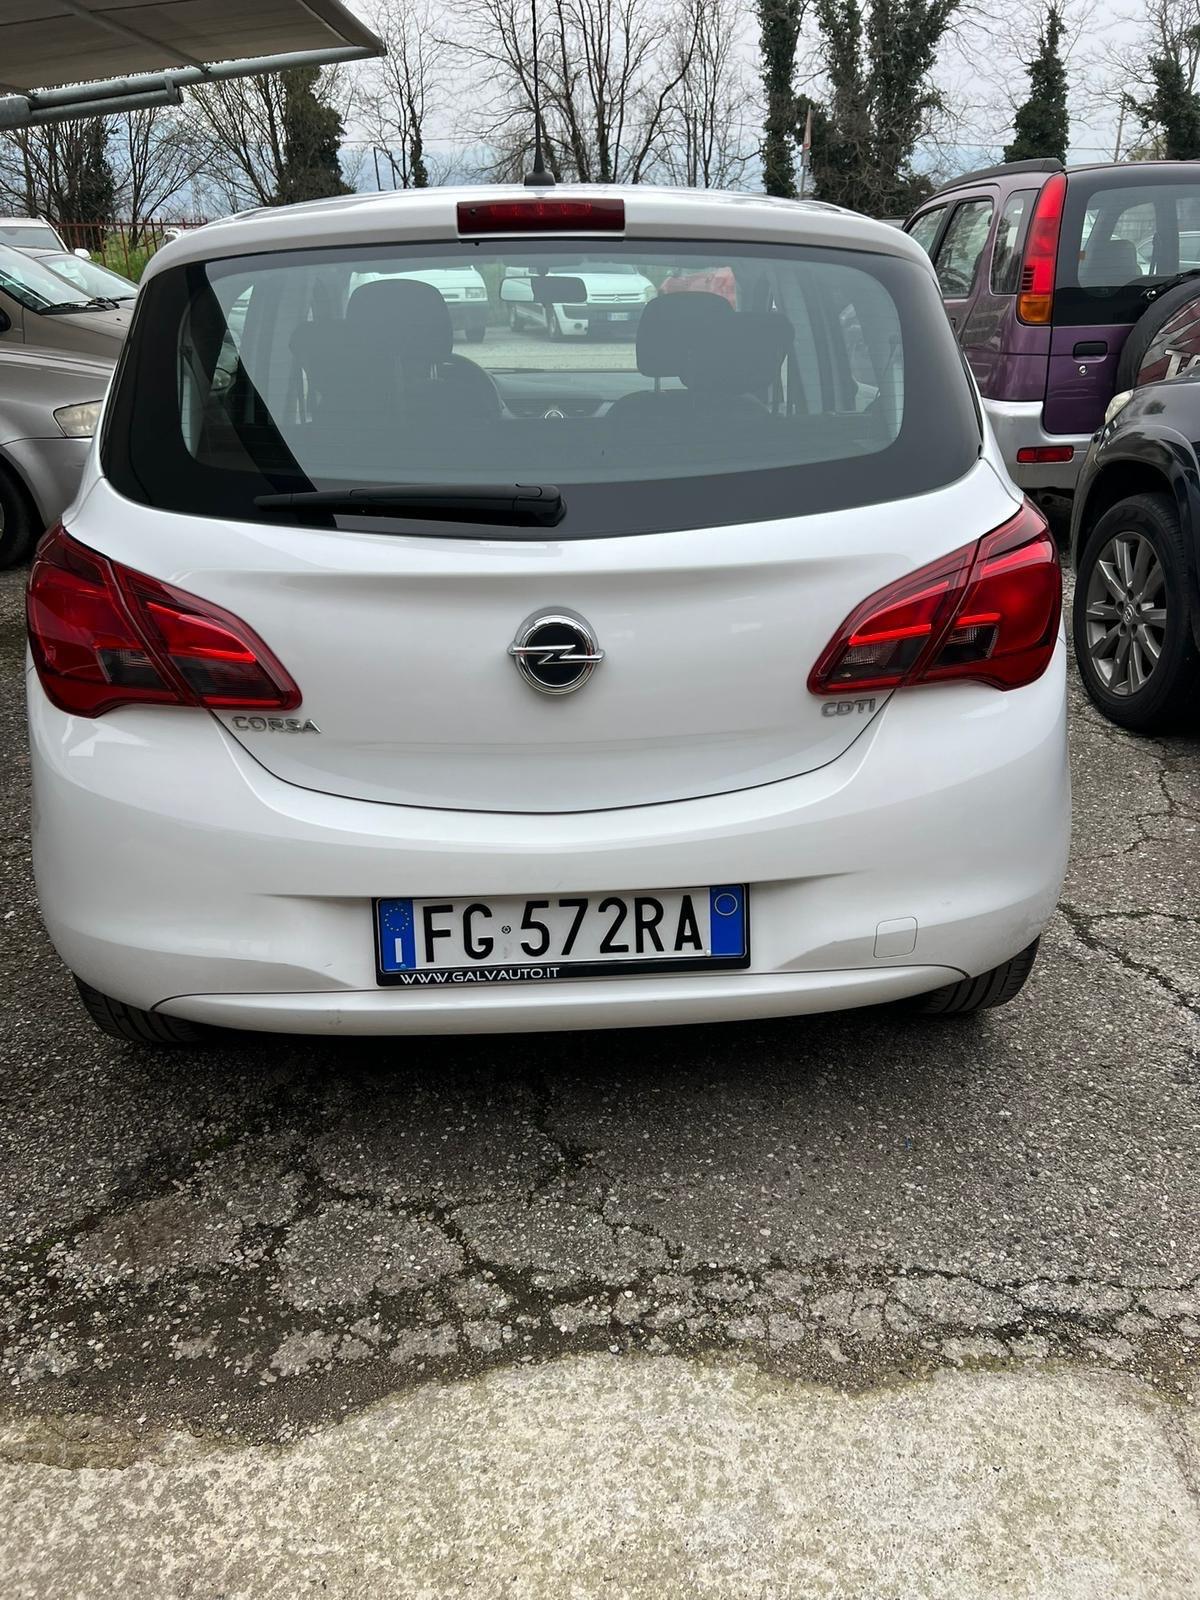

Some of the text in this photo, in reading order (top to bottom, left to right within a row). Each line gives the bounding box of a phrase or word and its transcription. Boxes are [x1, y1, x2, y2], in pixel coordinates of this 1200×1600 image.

[821, 698, 876, 717] CDTI
[231, 716, 321, 734] CORSA
[422, 894, 704, 963] FG 572RA
[400, 967, 560, 985] WWW.GALVAUTO.IT
